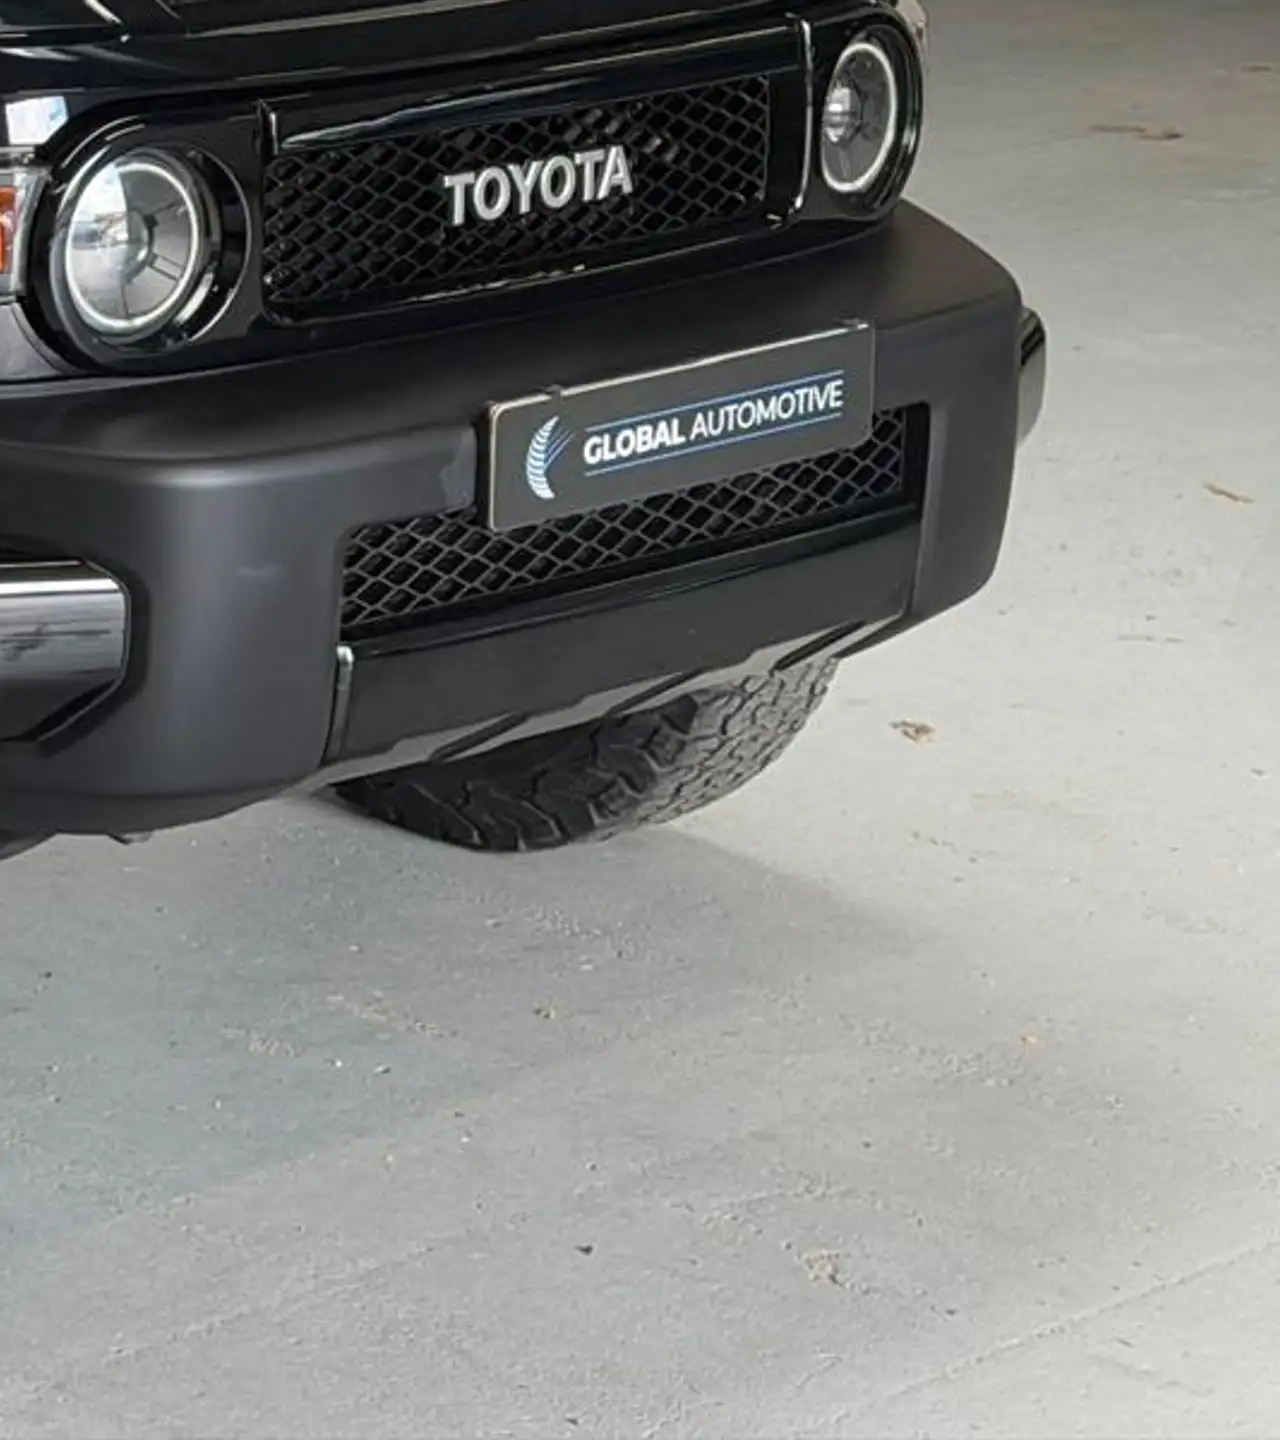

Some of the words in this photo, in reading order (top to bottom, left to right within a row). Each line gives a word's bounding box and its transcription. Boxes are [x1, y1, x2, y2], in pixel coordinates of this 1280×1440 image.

[444, 144, 634, 226] TOYOTA
[583, 416, 686, 464] GLOBAL
[689, 379, 845, 441] AUTOMOTIVE
